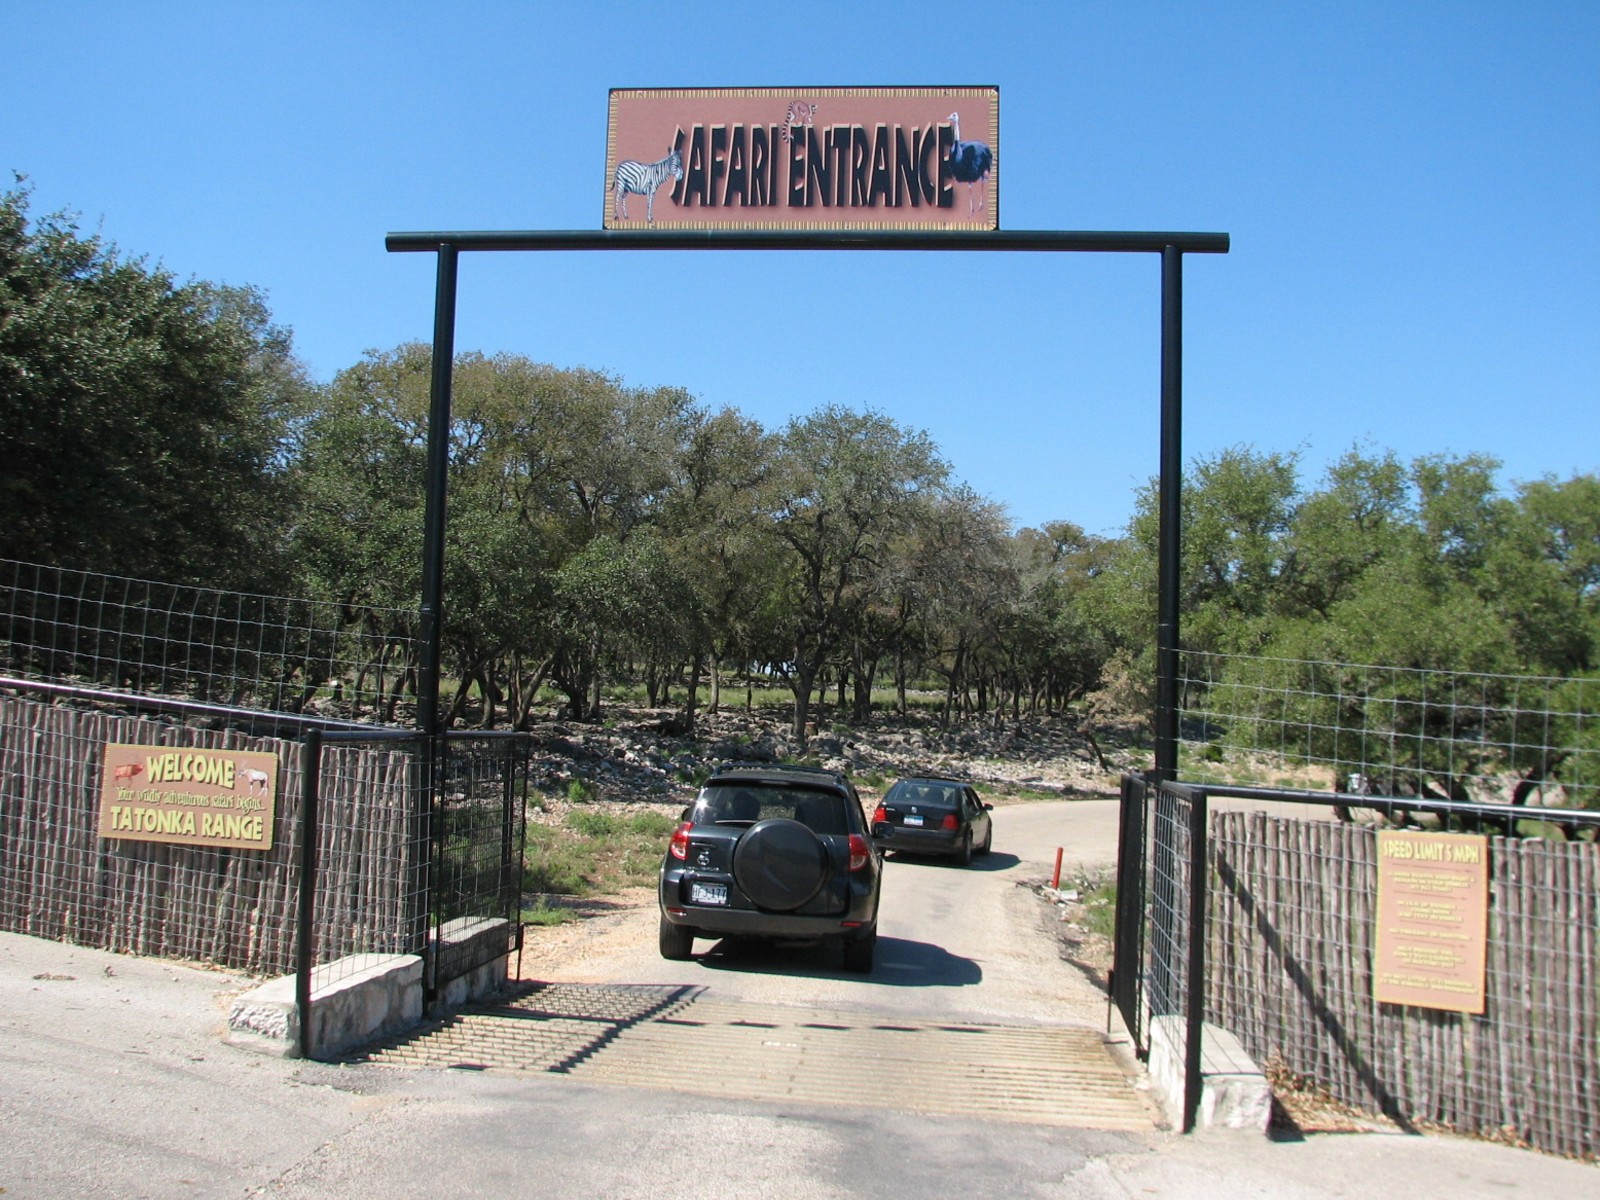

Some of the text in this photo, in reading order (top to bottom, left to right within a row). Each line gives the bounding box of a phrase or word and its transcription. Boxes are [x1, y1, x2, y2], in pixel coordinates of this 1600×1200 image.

[786, 122, 955, 208] ENTRANCE
[146, 752, 236, 789] WELCOME
[116, 786, 135, 802] Your
[110, 805, 264, 841] TATONKA RANGE
[1384, 839, 1414, 860] SPEED
[1415, 841, 1445, 862] LIMIT
[1454, 844, 1481, 865] MPH
